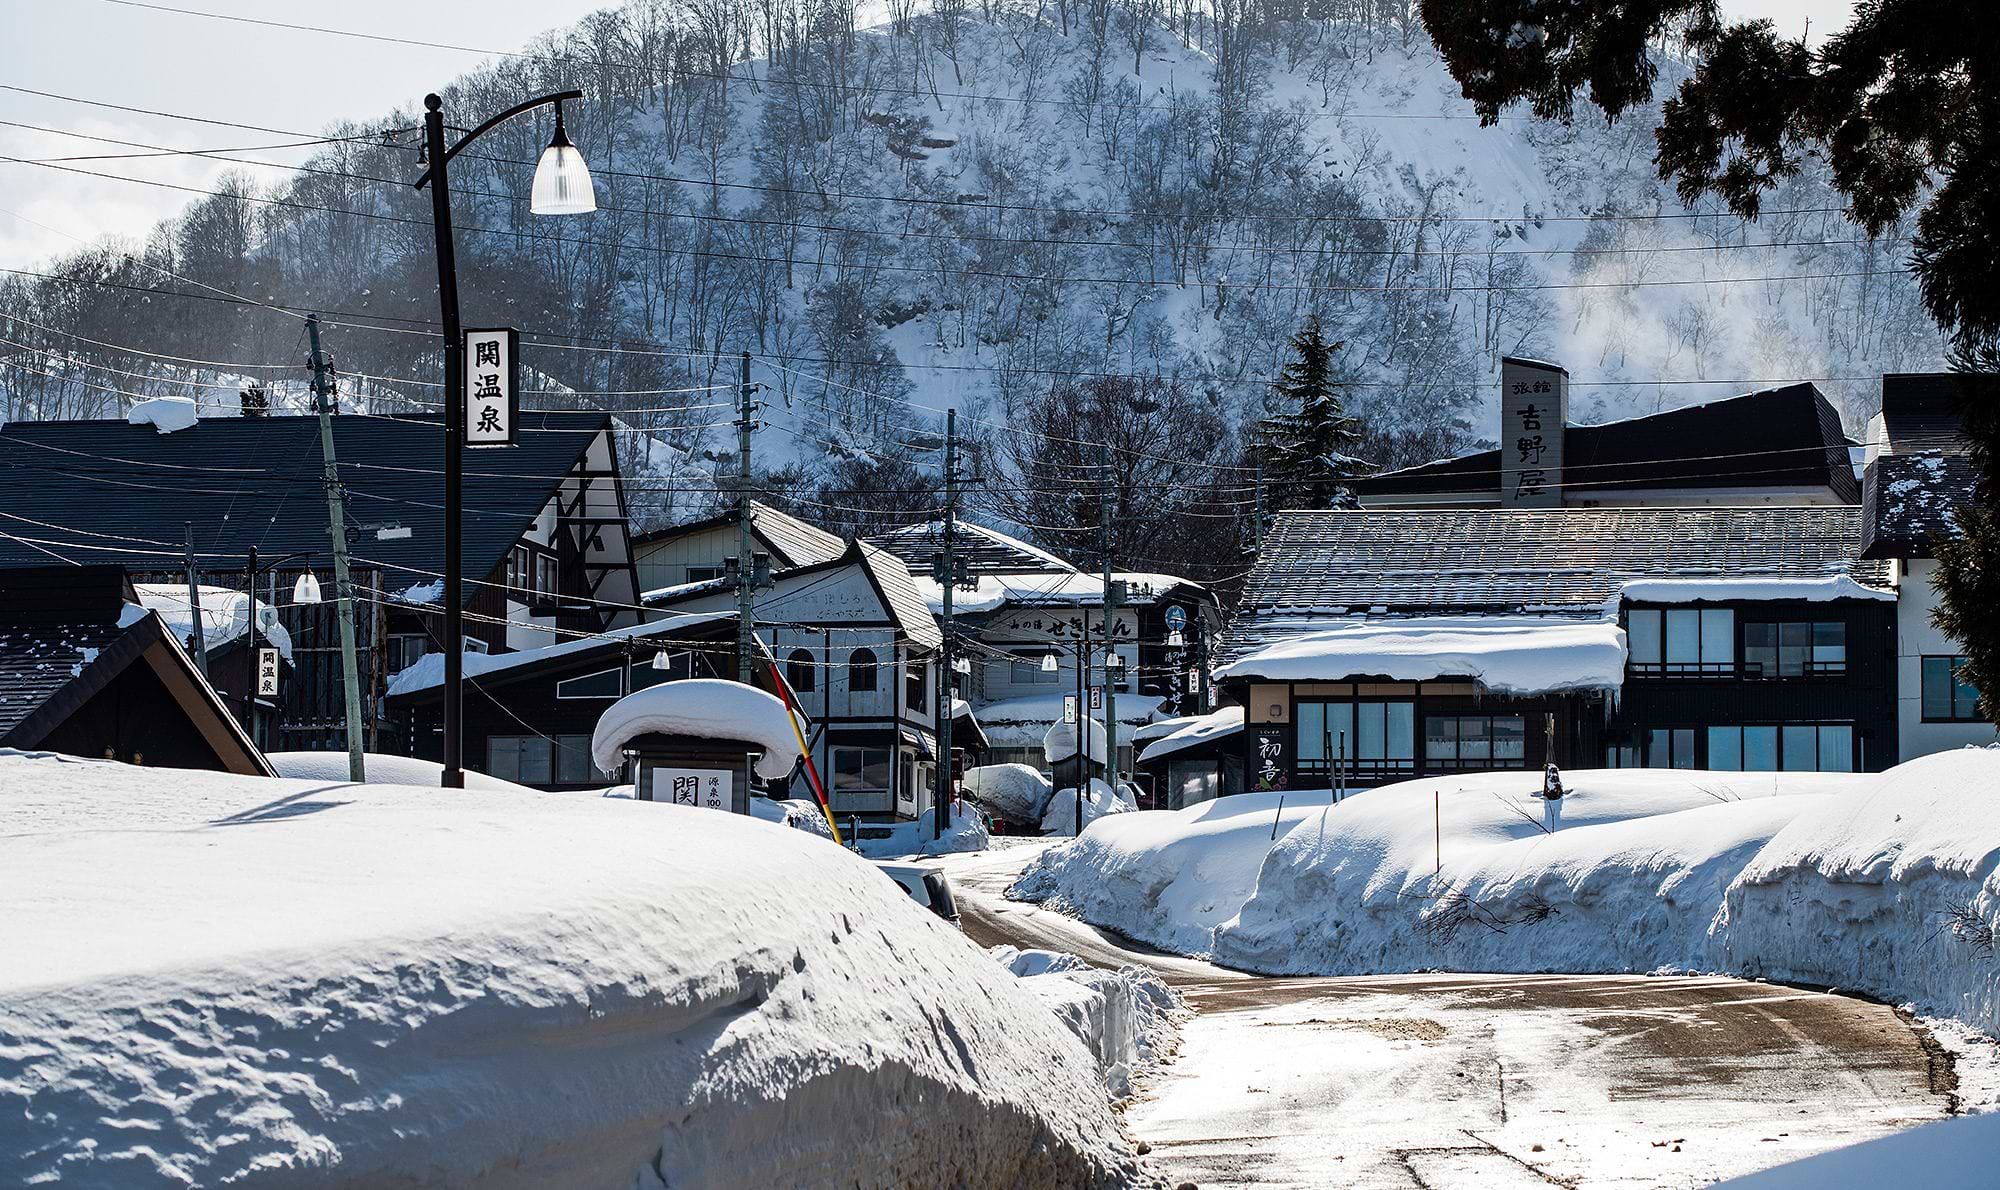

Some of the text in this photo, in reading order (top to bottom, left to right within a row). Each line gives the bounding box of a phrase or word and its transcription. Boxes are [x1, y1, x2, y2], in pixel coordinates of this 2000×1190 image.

[473, 340, 504, 433] 関温泉
[1511, 381, 1552, 395] 旅館
[1514, 403, 1547, 501] 吉野屋
[261, 651, 275, 692] 関温泉
[1258, 737, 1282, 781] 初音
[672, 776, 700, 807] 関
[706, 776, 721, 809] 源泉100
